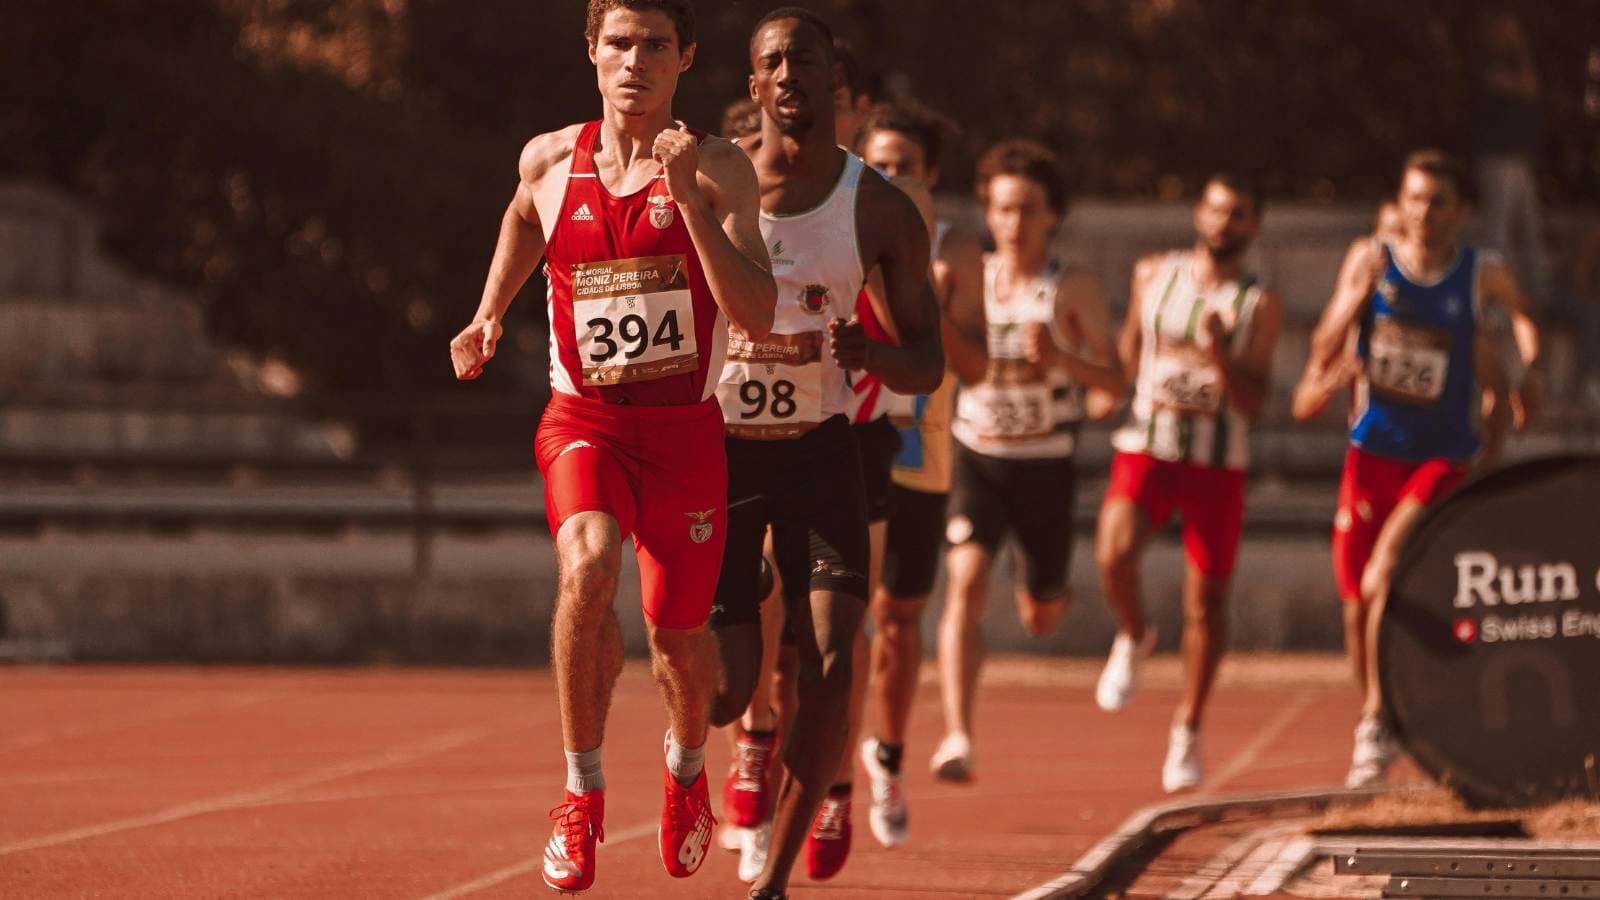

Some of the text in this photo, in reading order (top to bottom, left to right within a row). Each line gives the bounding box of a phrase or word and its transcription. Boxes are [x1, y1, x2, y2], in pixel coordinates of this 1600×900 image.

[576, 267, 613, 278] MEMORIAL
[576, 270, 659, 287] MONIZ PEREIRA
[576, 286, 604, 296] CIDADE
[616, 282, 642, 291] LISBOA
[586, 309, 685, 363] 394
[754, 343, 800, 355] PEREIRA
[739, 379, 797, 420] 98
[1453, 551, 1580, 609] Run
[1481, 614, 1557, 642] Swiss
